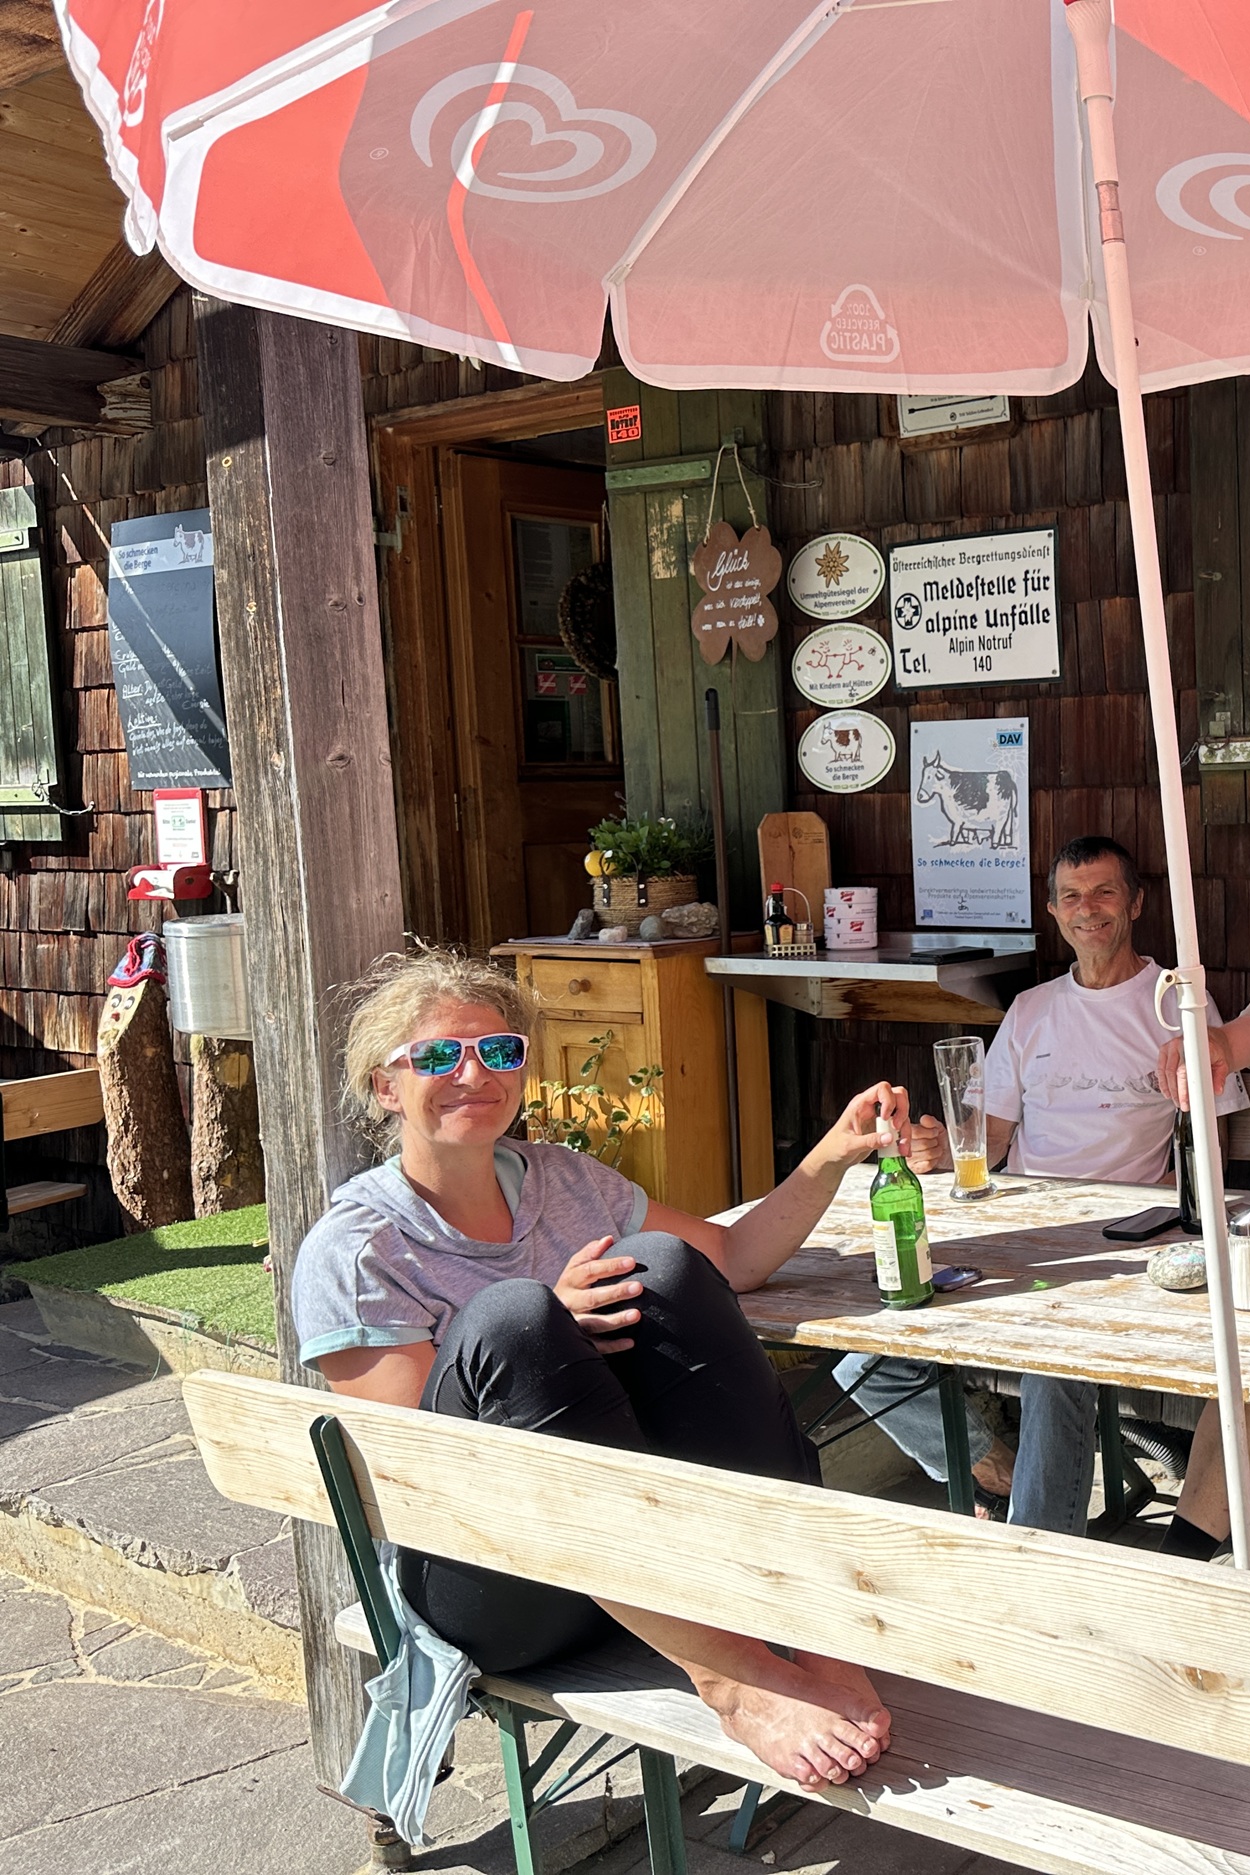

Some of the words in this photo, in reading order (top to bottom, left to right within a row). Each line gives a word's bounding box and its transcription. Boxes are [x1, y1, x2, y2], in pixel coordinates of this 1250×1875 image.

[611, 428, 639, 440] 140
[118, 550, 125, 559] So
[125, 546, 158, 558] schmecken
[123, 561, 133, 570] die
[134, 559, 151, 570] Berge
[707, 548, 750, 591] Glück
[1022, 569, 1050, 597] für
[800, 587, 856, 600] Umweltgütesiegel
[857, 586, 869, 594] der
[813, 599, 856, 609] Alpenvereine
[925, 609, 978, 636] alpine
[985, 602, 1051, 632] Unfälle
[949, 637, 975, 656] Alpin
[978, 632, 1013, 651] Notruf
[900, 648, 931, 674] Tel.
[973, 655, 992, 672] 140
[820, 681, 841, 690] Kindern
[842, 680, 852, 688] auf
[853, 679, 873, 687] Hütten
[999, 733, 1022, 745] DAV
[834, 764, 864, 772] schmecken
[832, 773, 841, 781] die
[842, 773, 859, 781] Berge
[917, 858, 927, 867] So
[930, 857, 975, 868] schmecken
[979, 858, 992, 868] die
[994, 857, 1026, 869] Berge!
